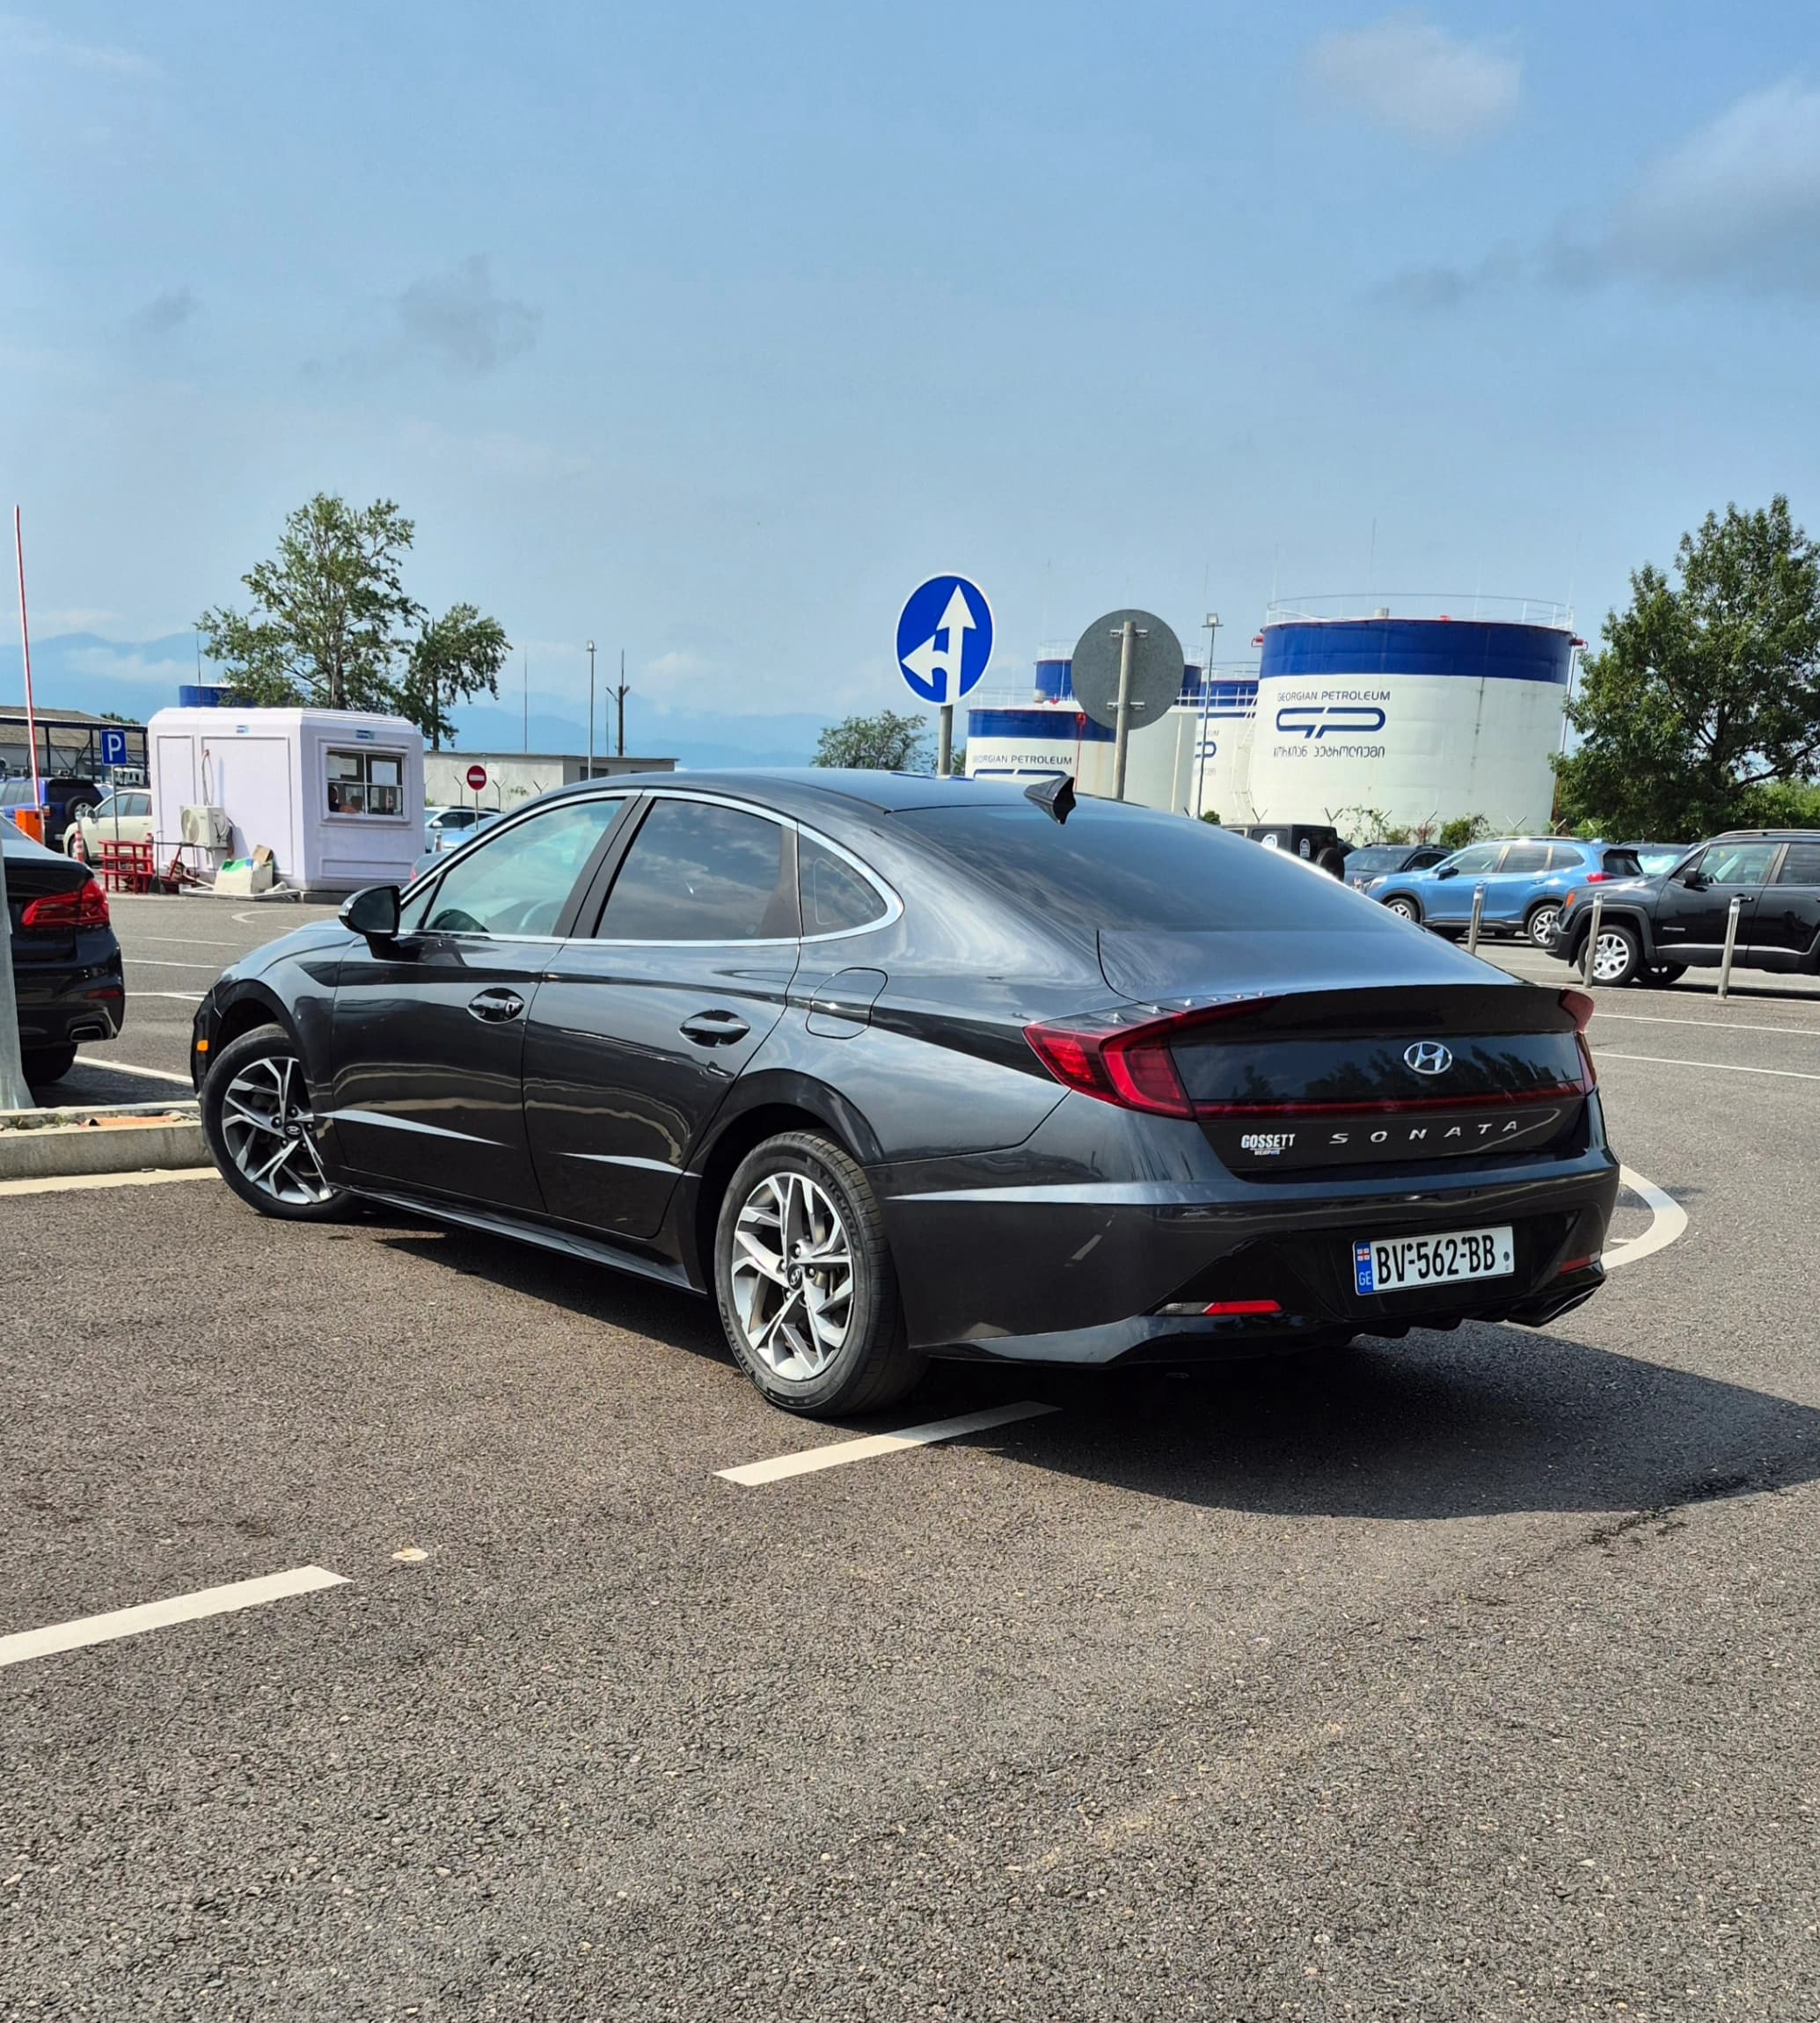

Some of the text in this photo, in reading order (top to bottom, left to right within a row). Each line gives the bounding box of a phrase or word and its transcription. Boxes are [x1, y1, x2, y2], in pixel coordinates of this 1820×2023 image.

[1277, 690, 1391, 702] GEORGIAN PETROLEUM
[107, 734, 122, 762] P
[1011, 755, 1073, 765] PETROLEUM
[1328, 1120, 1518, 1144] SONATA
[1241, 1133, 1296, 1149] GOSSETT
[1358, 1270, 1372, 1286] GE
